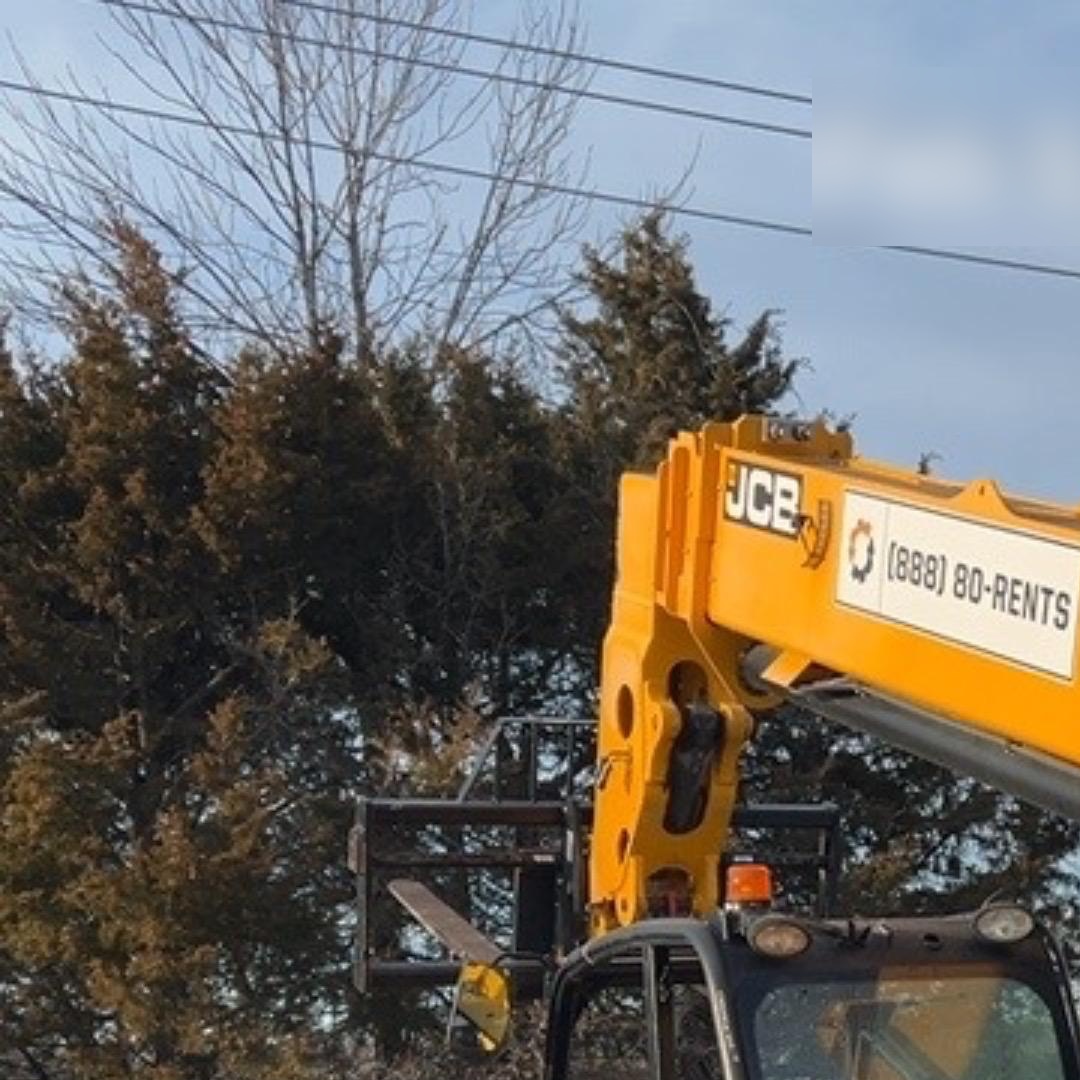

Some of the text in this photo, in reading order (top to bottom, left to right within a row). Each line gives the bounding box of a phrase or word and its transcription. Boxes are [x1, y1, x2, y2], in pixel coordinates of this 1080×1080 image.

[726, 463, 799, 535] JCB
[887, 541, 1072, 631] (888) 80-RENTS
